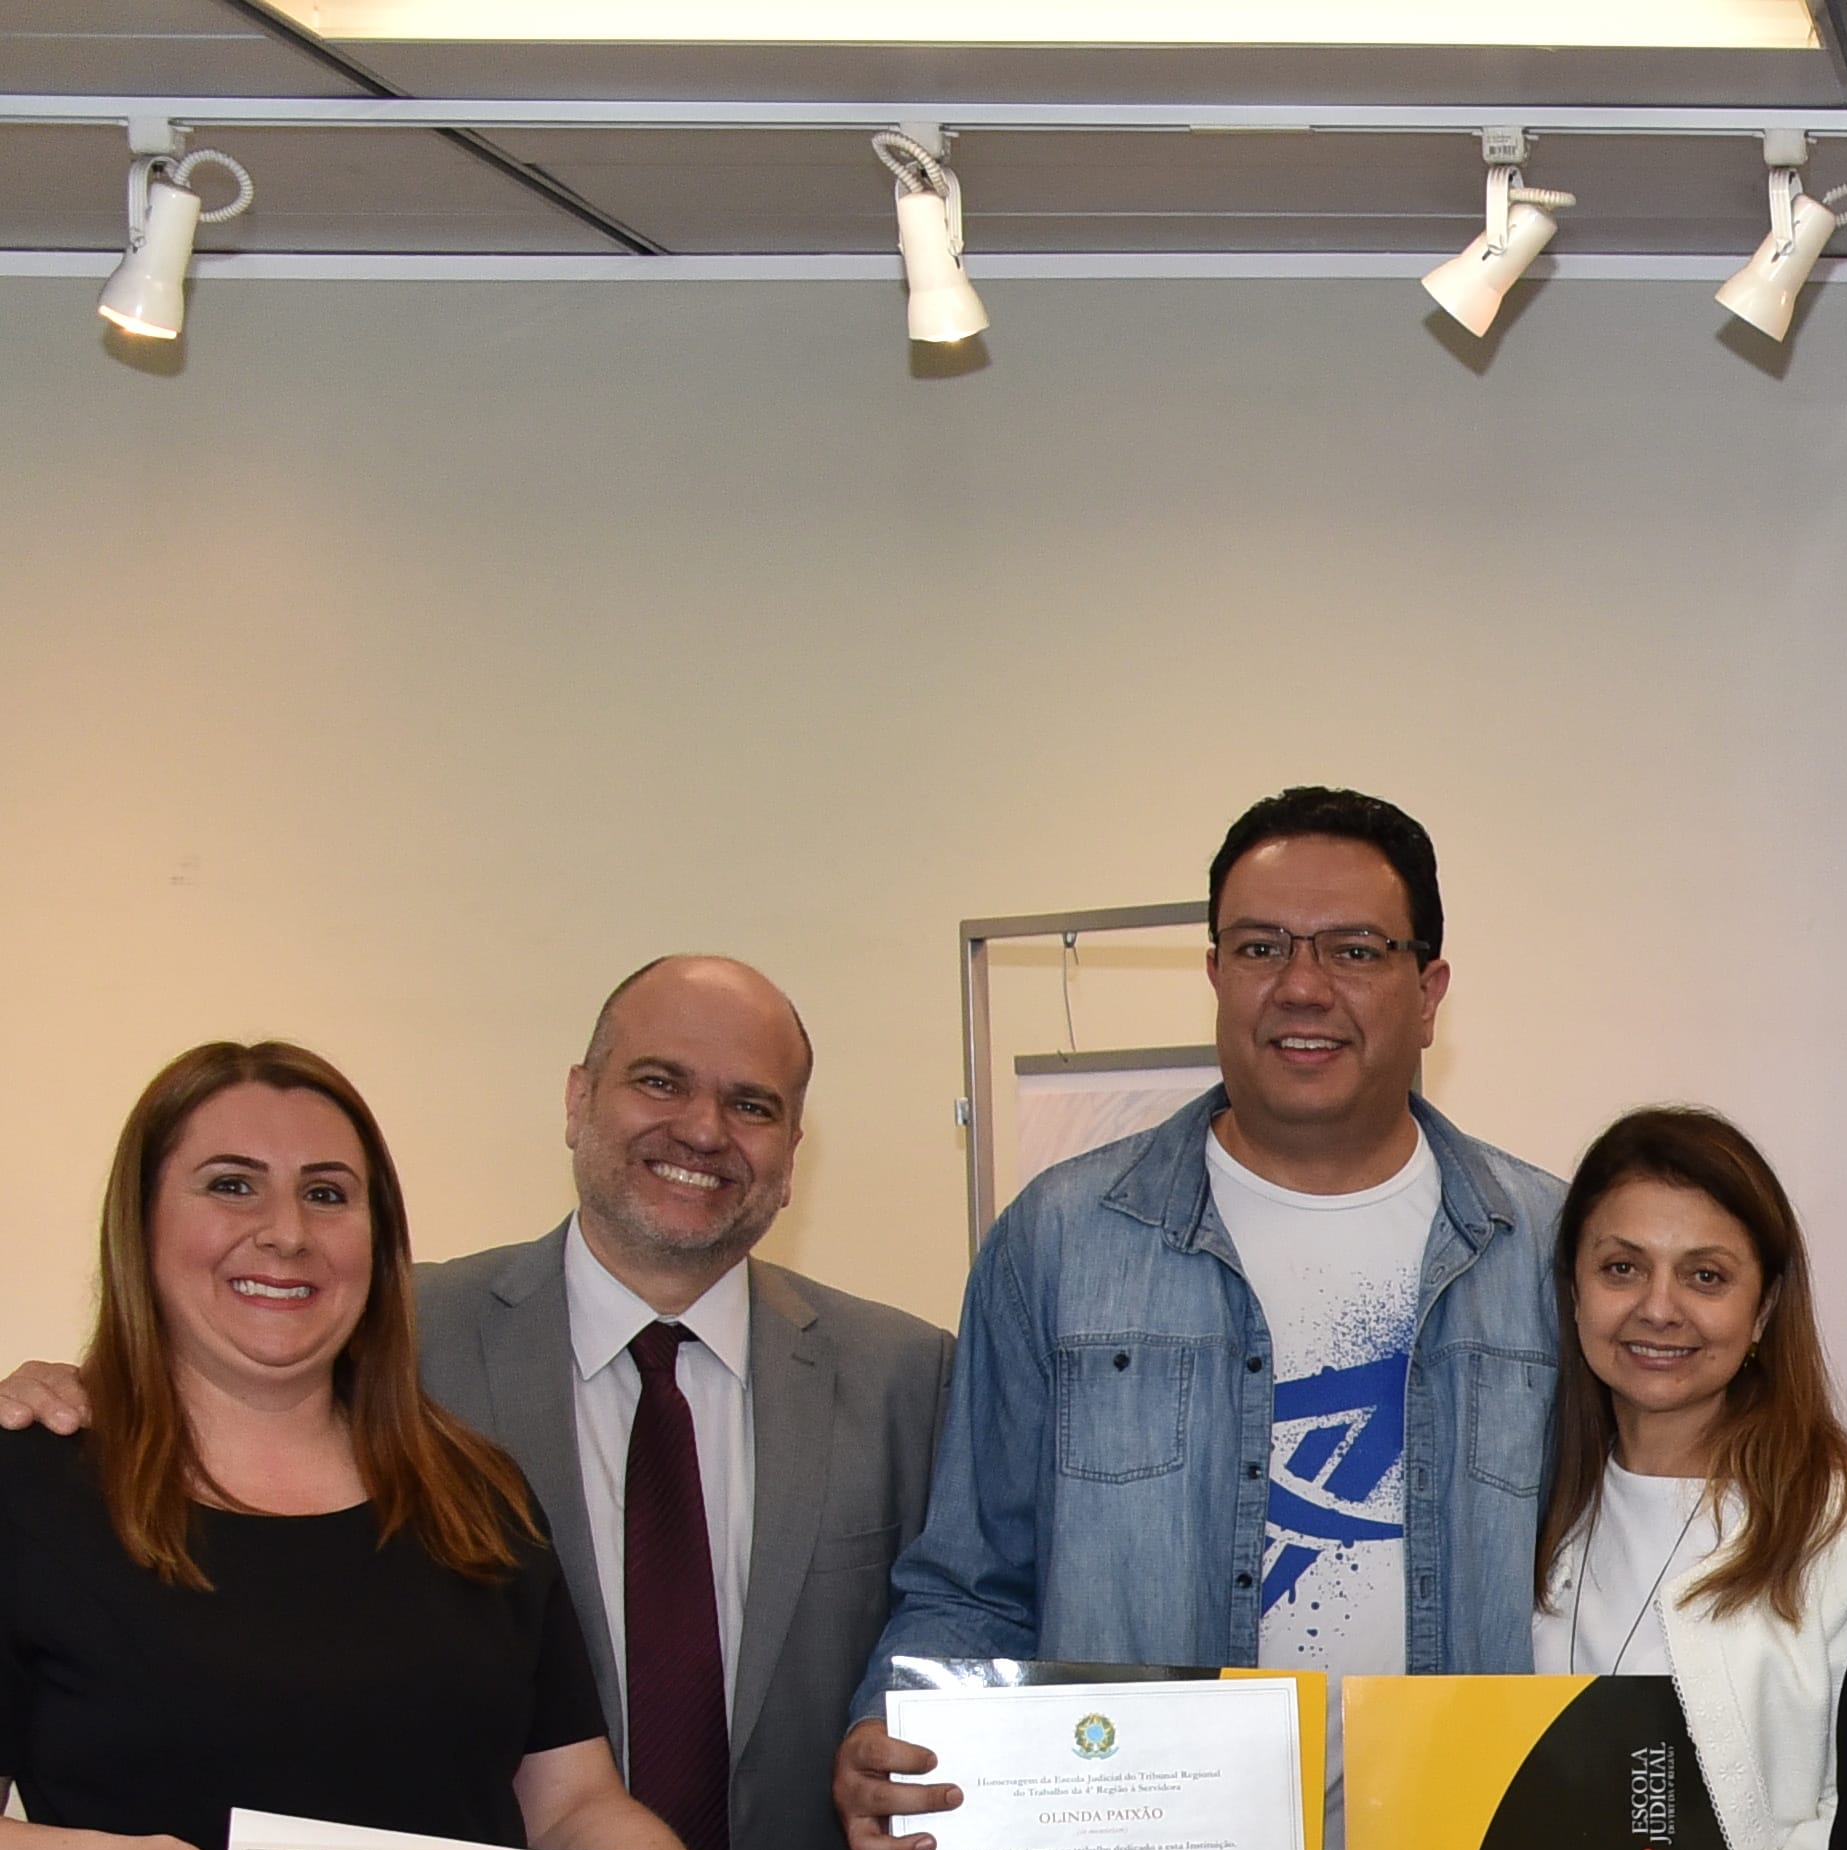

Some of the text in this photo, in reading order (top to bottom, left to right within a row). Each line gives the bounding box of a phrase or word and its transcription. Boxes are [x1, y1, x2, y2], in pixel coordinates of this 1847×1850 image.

[1039, 1806, 1164, 1824] OLINDA PAIXÃO
[1630, 1747, 1649, 1834] ESCOLA
[1649, 1741, 1672, 1845] JUDICIAL
